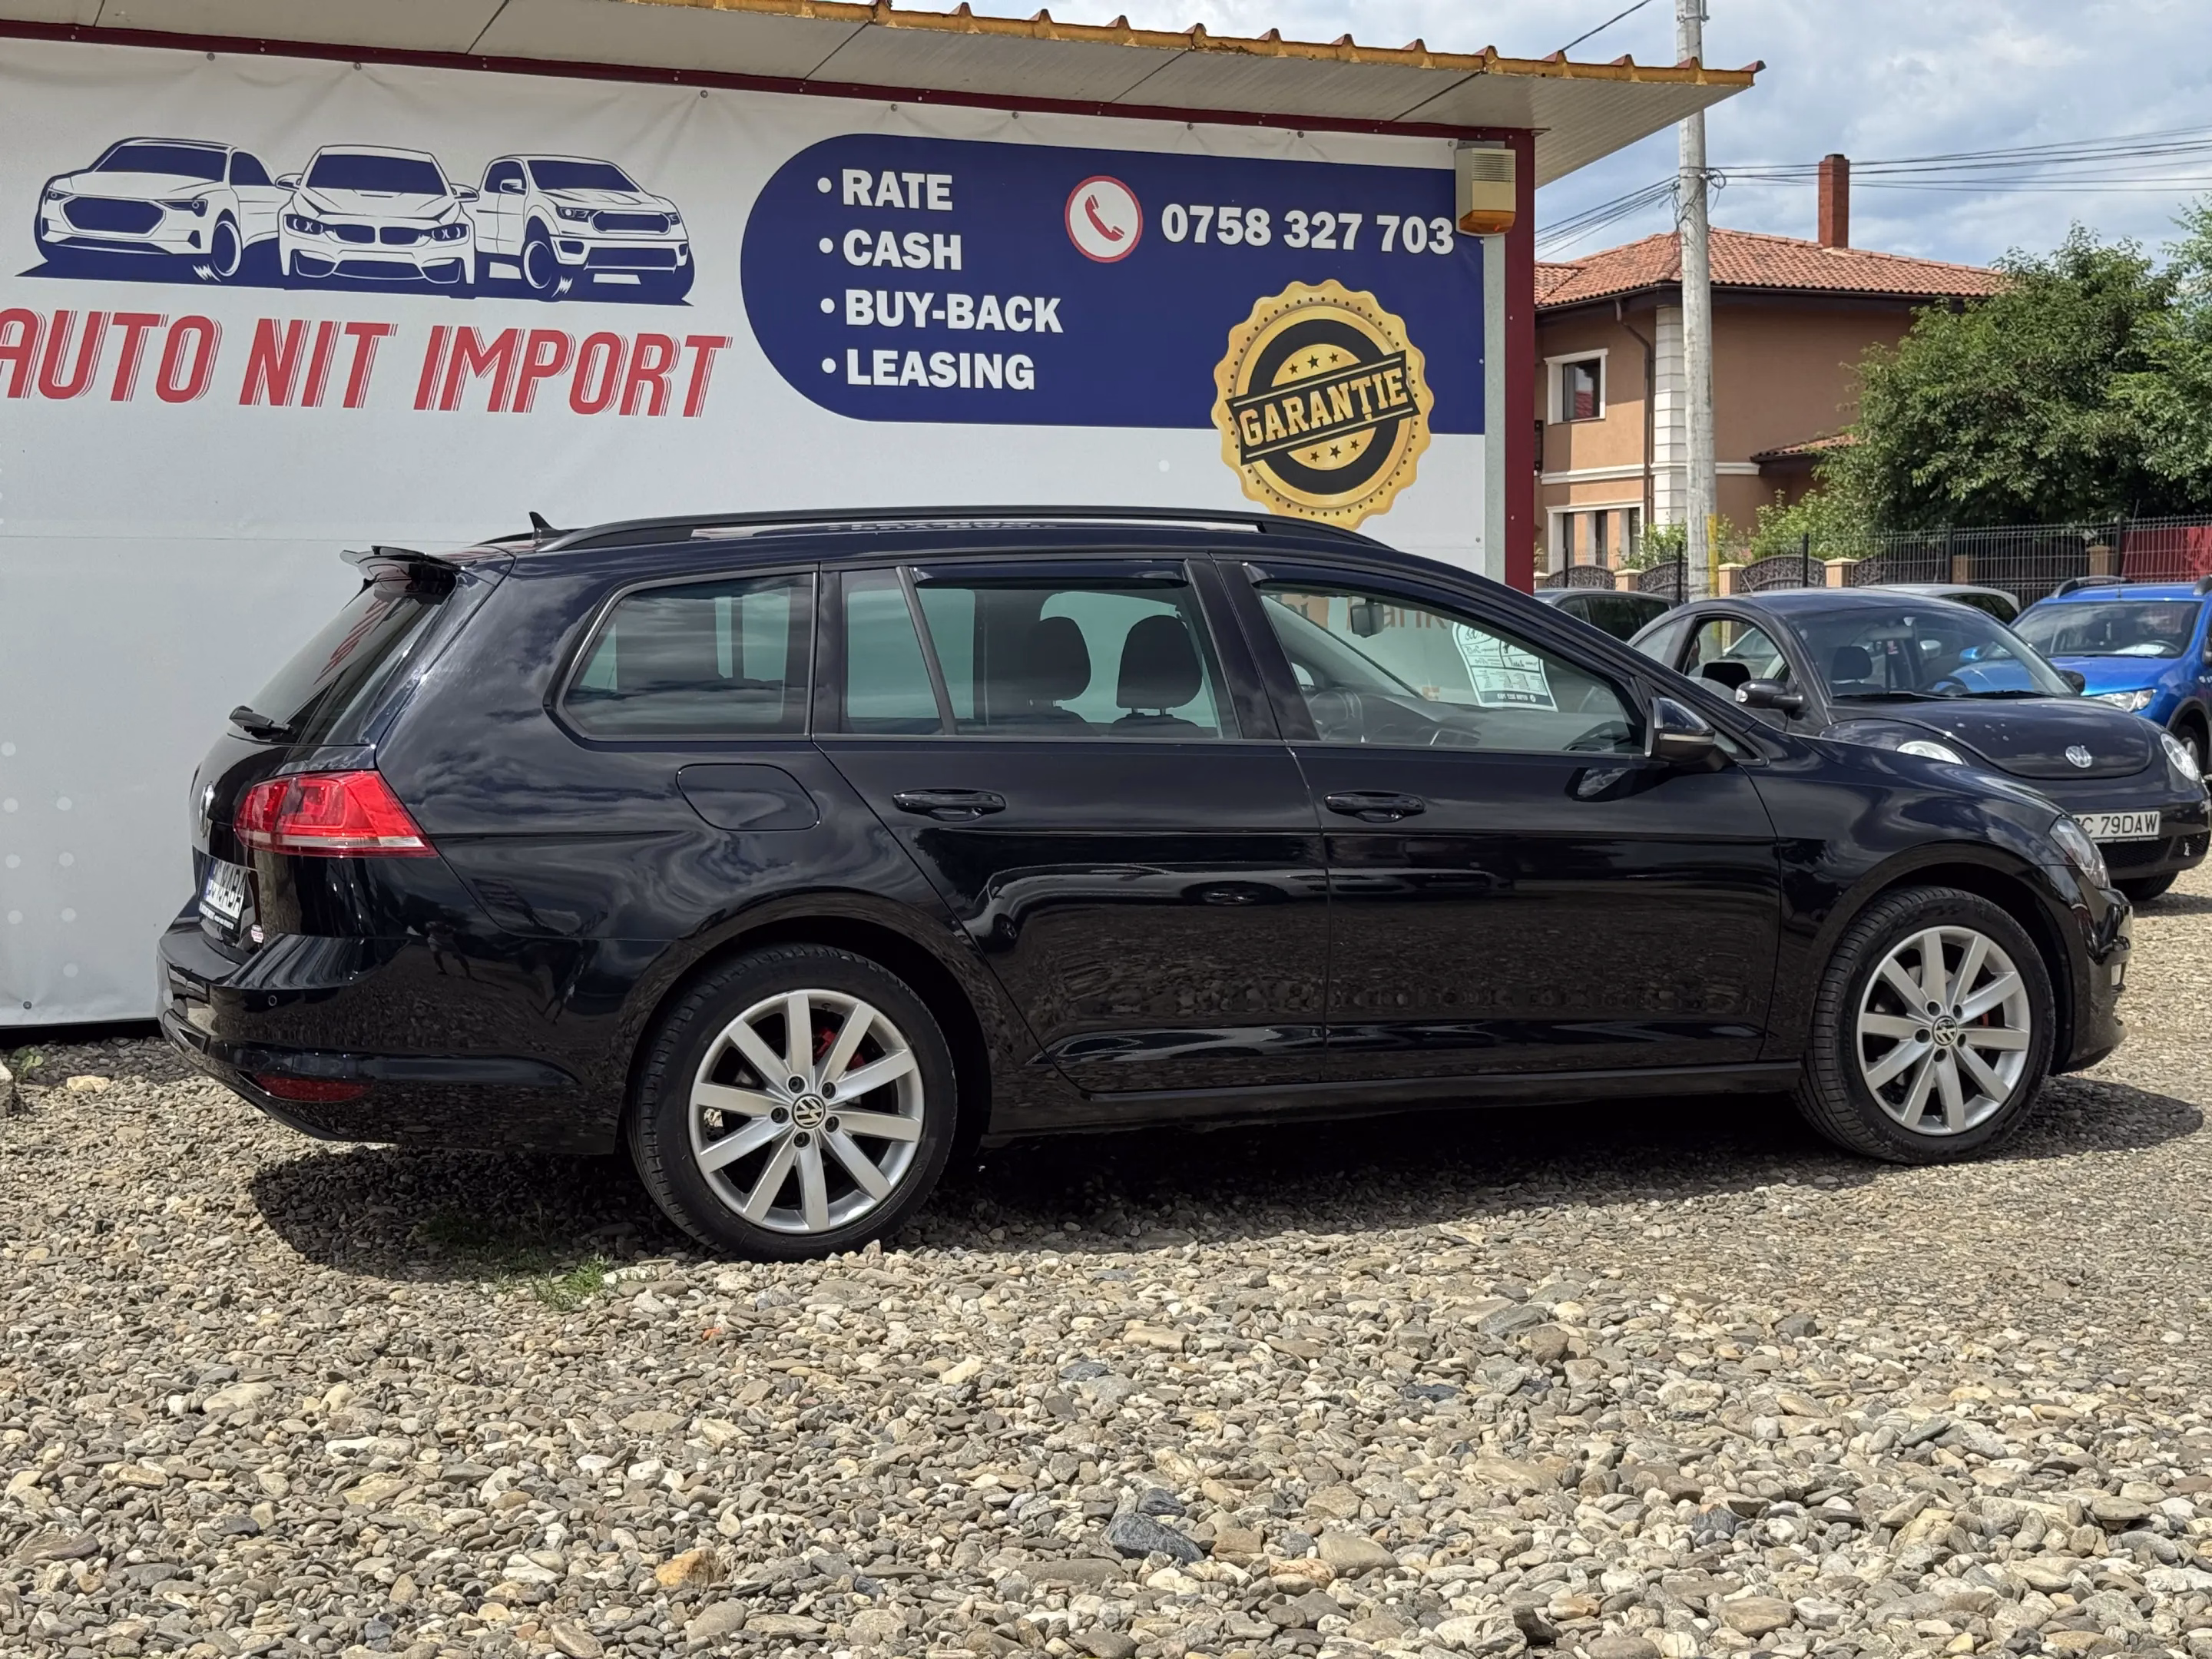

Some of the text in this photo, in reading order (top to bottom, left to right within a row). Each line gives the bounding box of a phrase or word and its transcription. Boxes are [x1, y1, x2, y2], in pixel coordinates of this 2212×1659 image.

[843, 168, 952, 210] RATE
[843, 229, 962, 270] CASH
[1161, 204, 1454, 254] 0758 327 703
[846, 289, 1064, 333] BUY-BACK
[0, 309, 732, 418] AUTO NIT IMPORT
[846, 349, 1035, 390] LEASING
[2101, 814, 2158, 835] 79DAW
